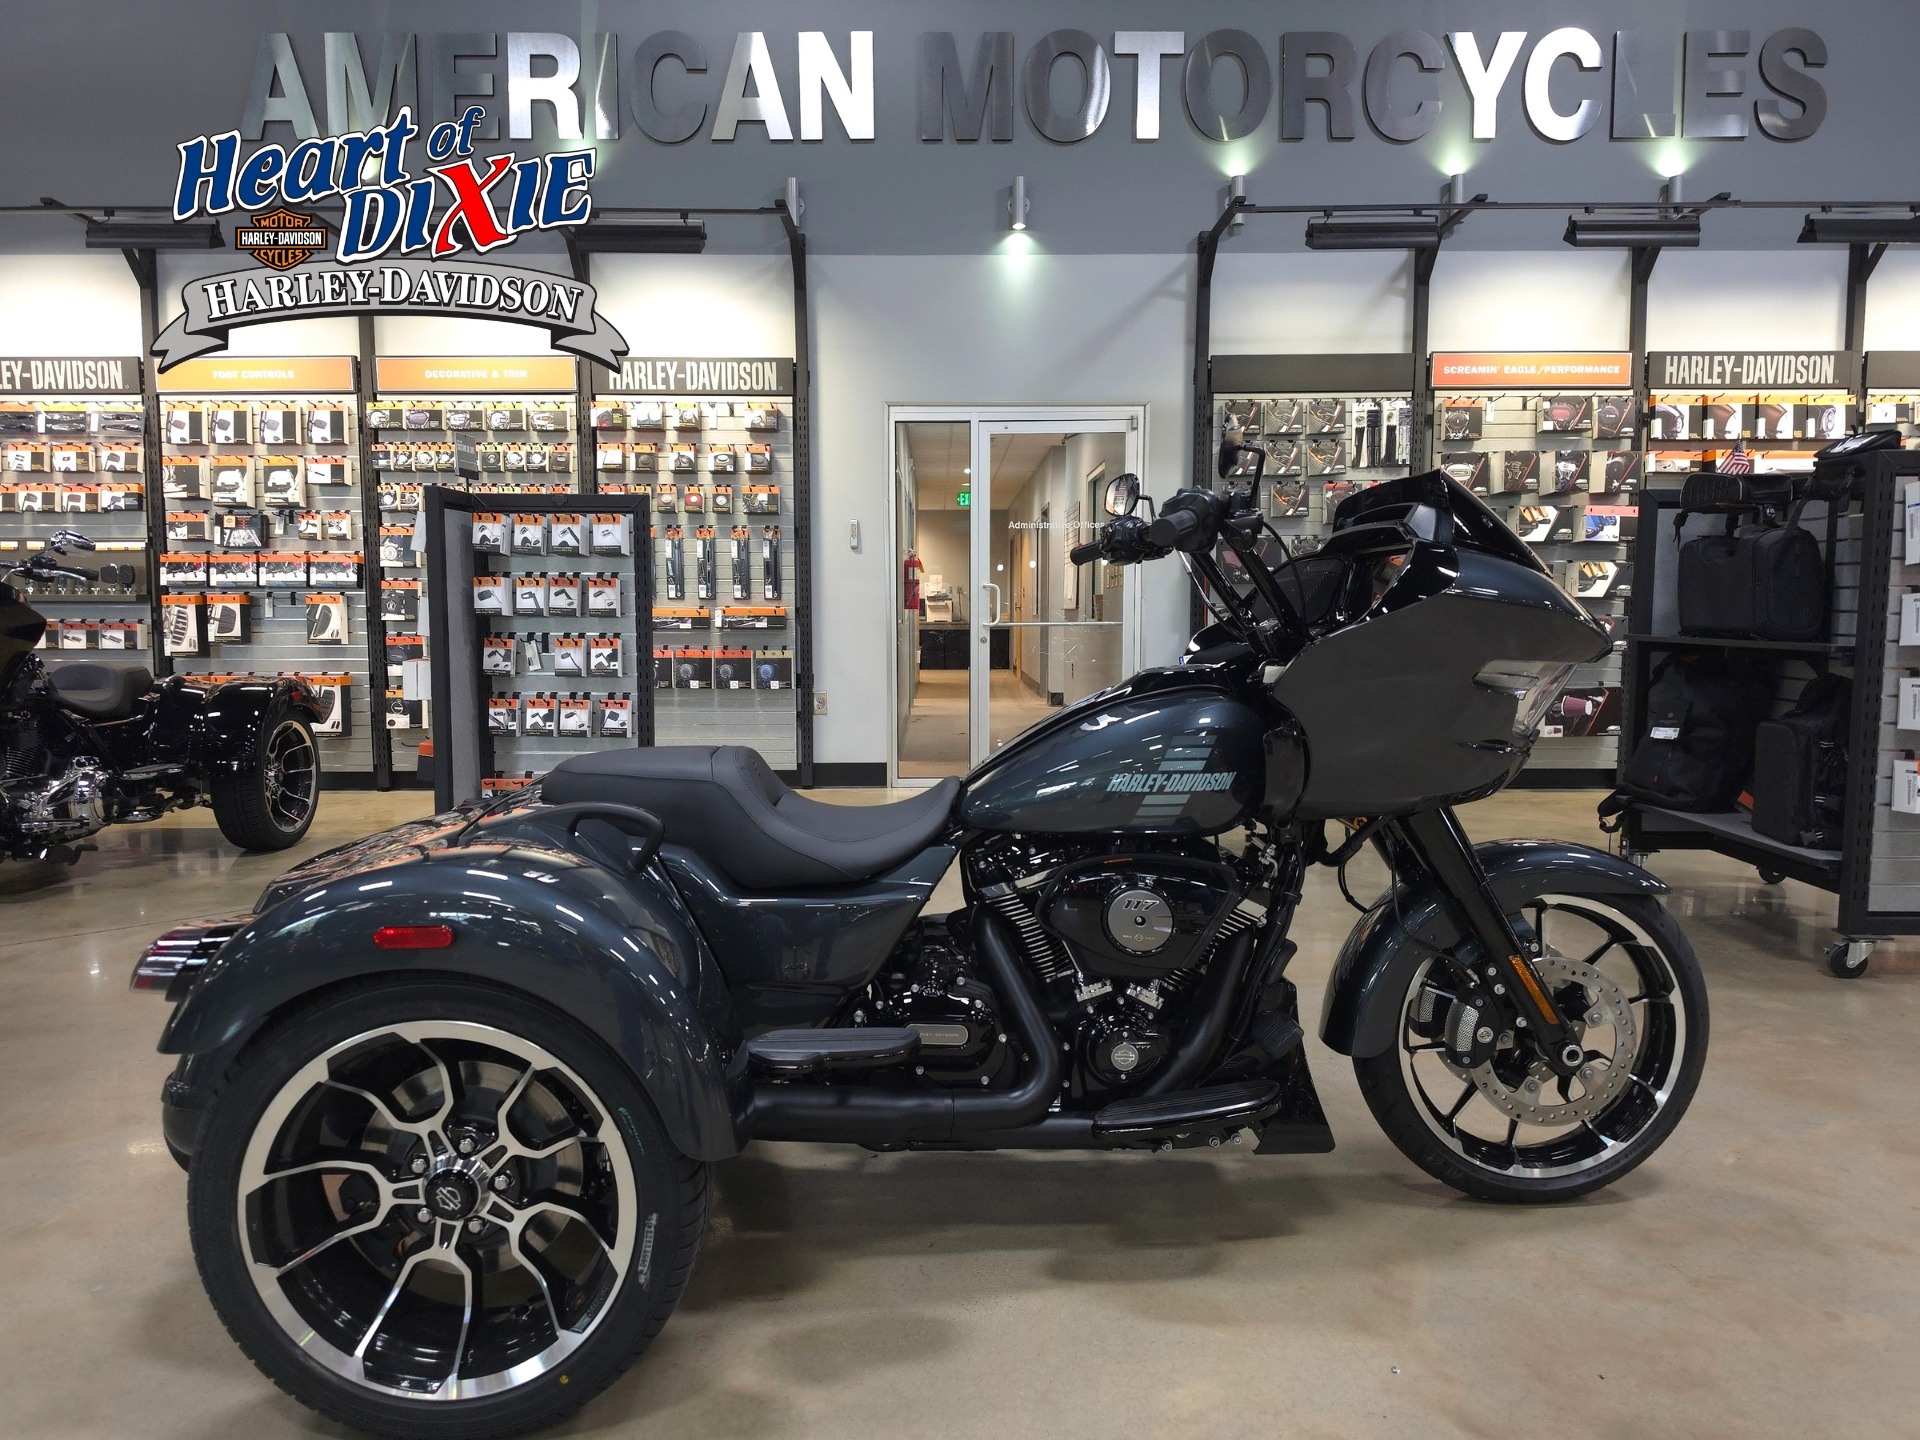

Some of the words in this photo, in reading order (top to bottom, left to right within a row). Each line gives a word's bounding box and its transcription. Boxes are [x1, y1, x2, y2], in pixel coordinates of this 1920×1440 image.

[240, 29, 875, 142] AMERICAN
[919, 26, 1829, 142] MOTORCYCLES
[212, 370, 239, 379] FOOT
[241, 370, 295, 379] CONTROLS
[424, 369, 489, 379] DECORATIVE
[491, 370, 500, 378] &
[503, 369, 528, 378] TRIM
[608, 360, 777, 391] HARLEY-DAVIDSON
[1443, 364, 1501, 375] SCREAMIN'
[1664, 354, 1836, 385] HARLEY-DAVIDSON
[1008, 520, 1071, 530] Administrative
[1105, 771, 1237, 793] HARLEY-DAVIDSON
[1122, 898, 1160, 912] 117
